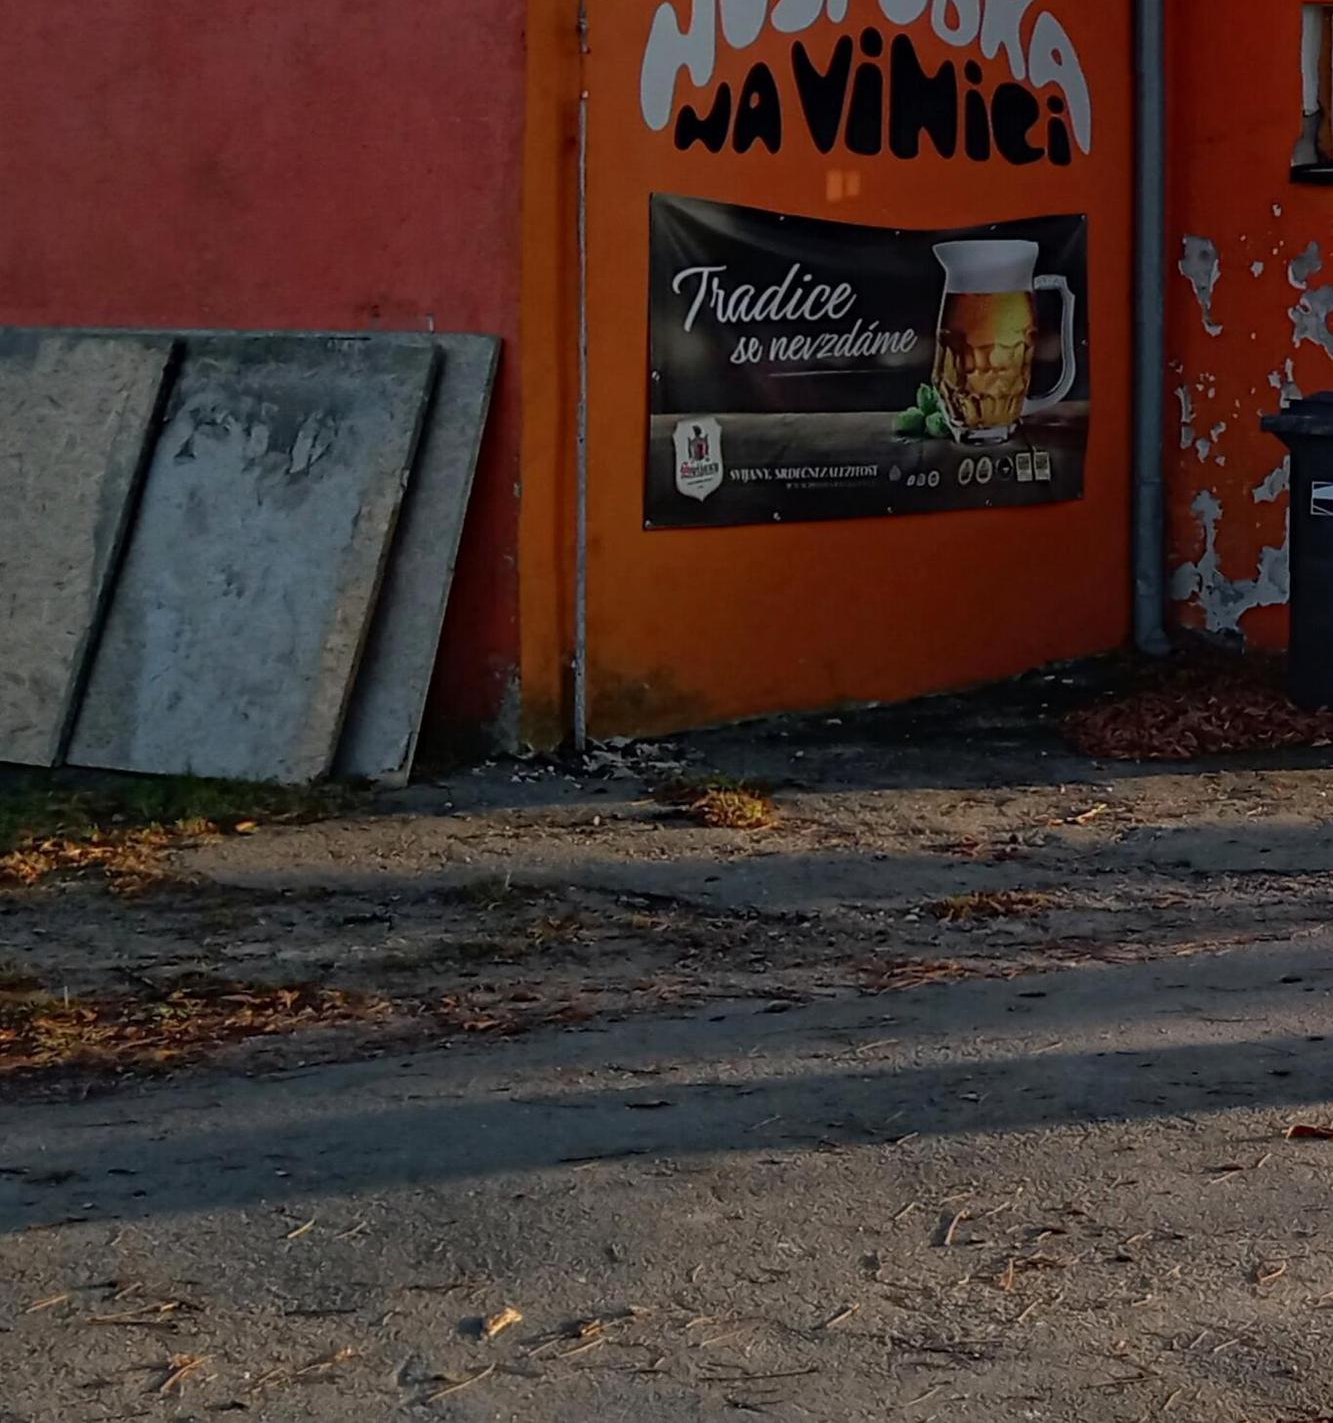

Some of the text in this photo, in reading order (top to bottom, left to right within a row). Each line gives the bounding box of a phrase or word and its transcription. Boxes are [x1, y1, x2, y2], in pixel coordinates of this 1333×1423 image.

[674, 62, 783, 154] NA
[672, 263, 857, 332] Tradice
[730, 318, 918, 364] se nevzdáme
